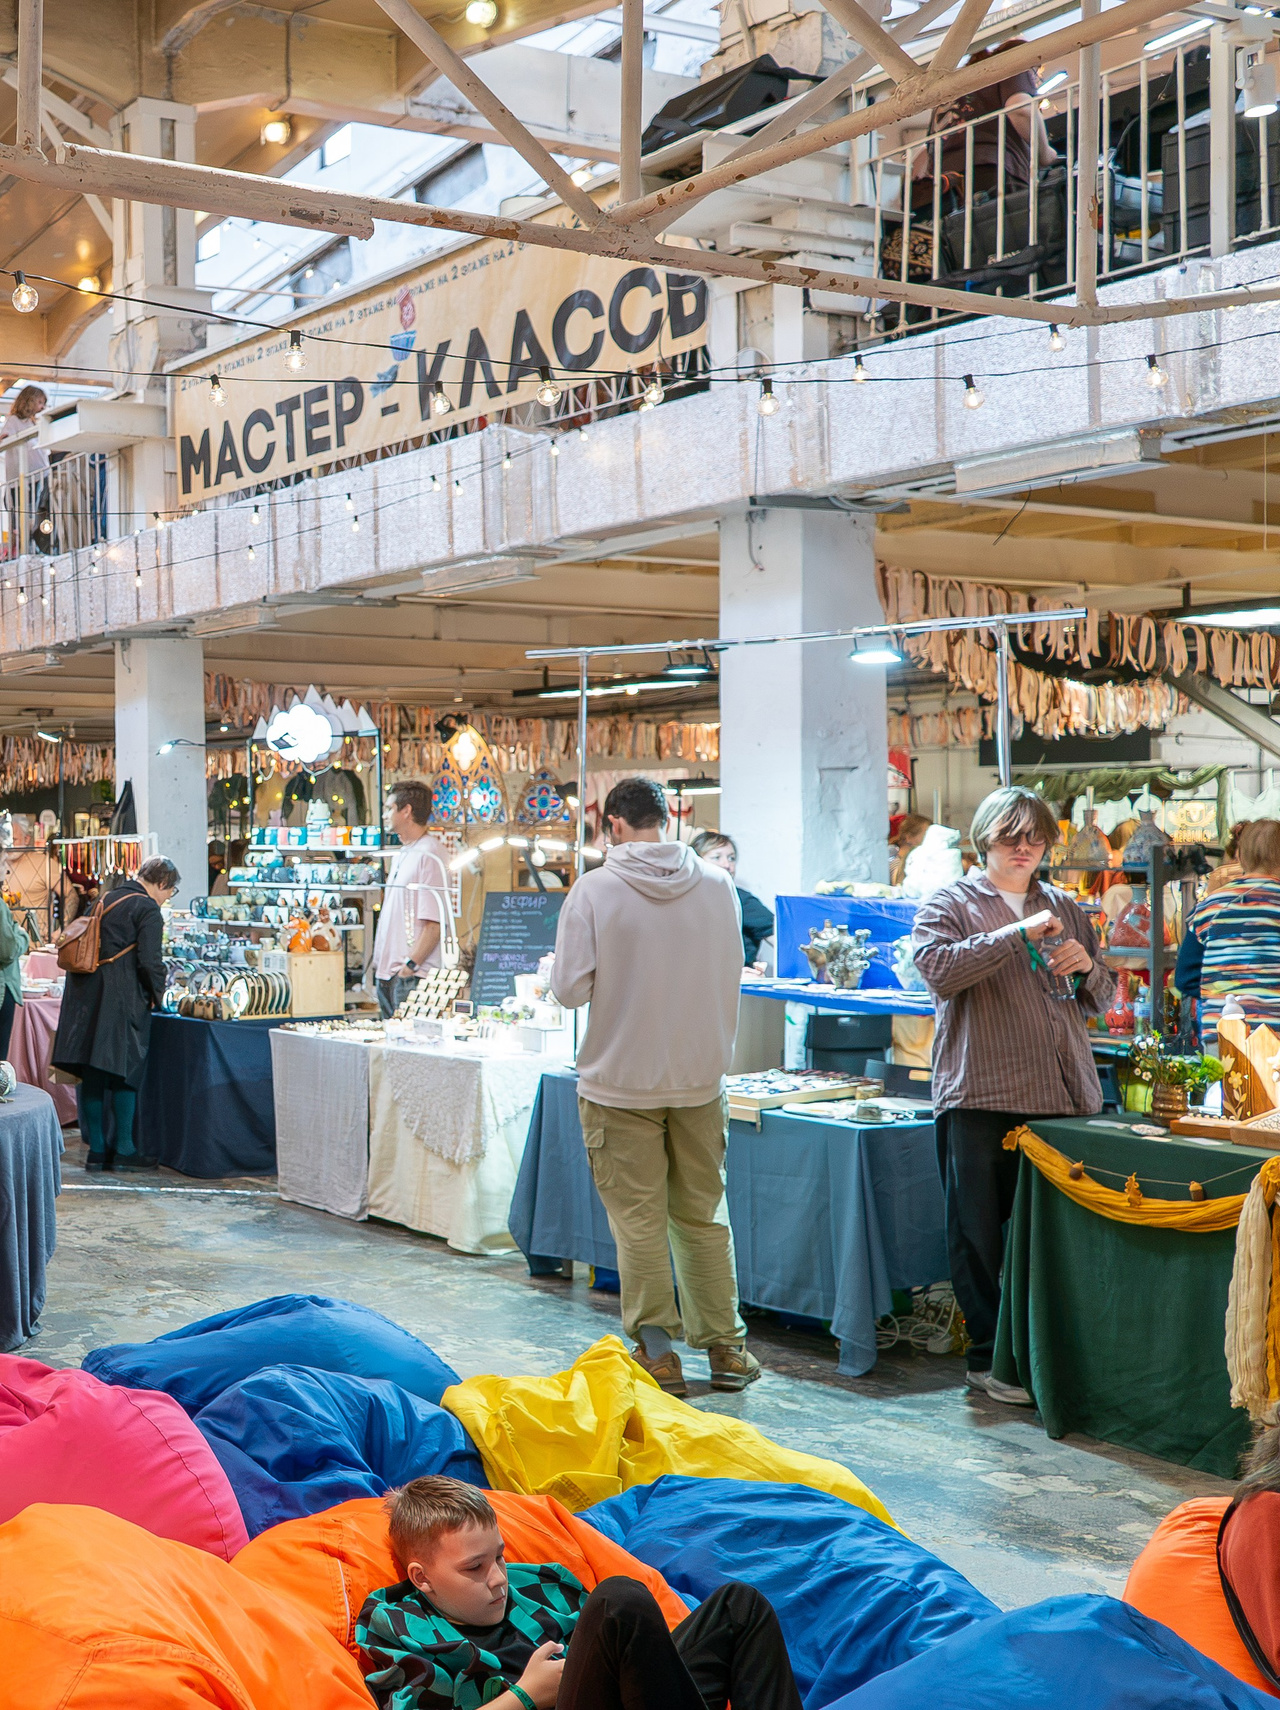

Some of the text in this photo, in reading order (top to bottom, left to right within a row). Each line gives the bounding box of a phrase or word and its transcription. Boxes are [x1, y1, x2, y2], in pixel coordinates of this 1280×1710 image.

[257, 346, 263, 360] 2
[348, 309, 355, 324] 2
[356, 301, 384, 320] ЭТАЖЕ
[438, 273, 449, 286] НА
[451, 265, 459, 280] 2
[461, 254, 490, 276] ЭТАЖЕ
[492, 249, 505, 262] НА
[507, 240, 515, 256] 2
[181, 377, 364, 494] МАСТЕР
[501, 895, 548, 909] ЗЕФИР
